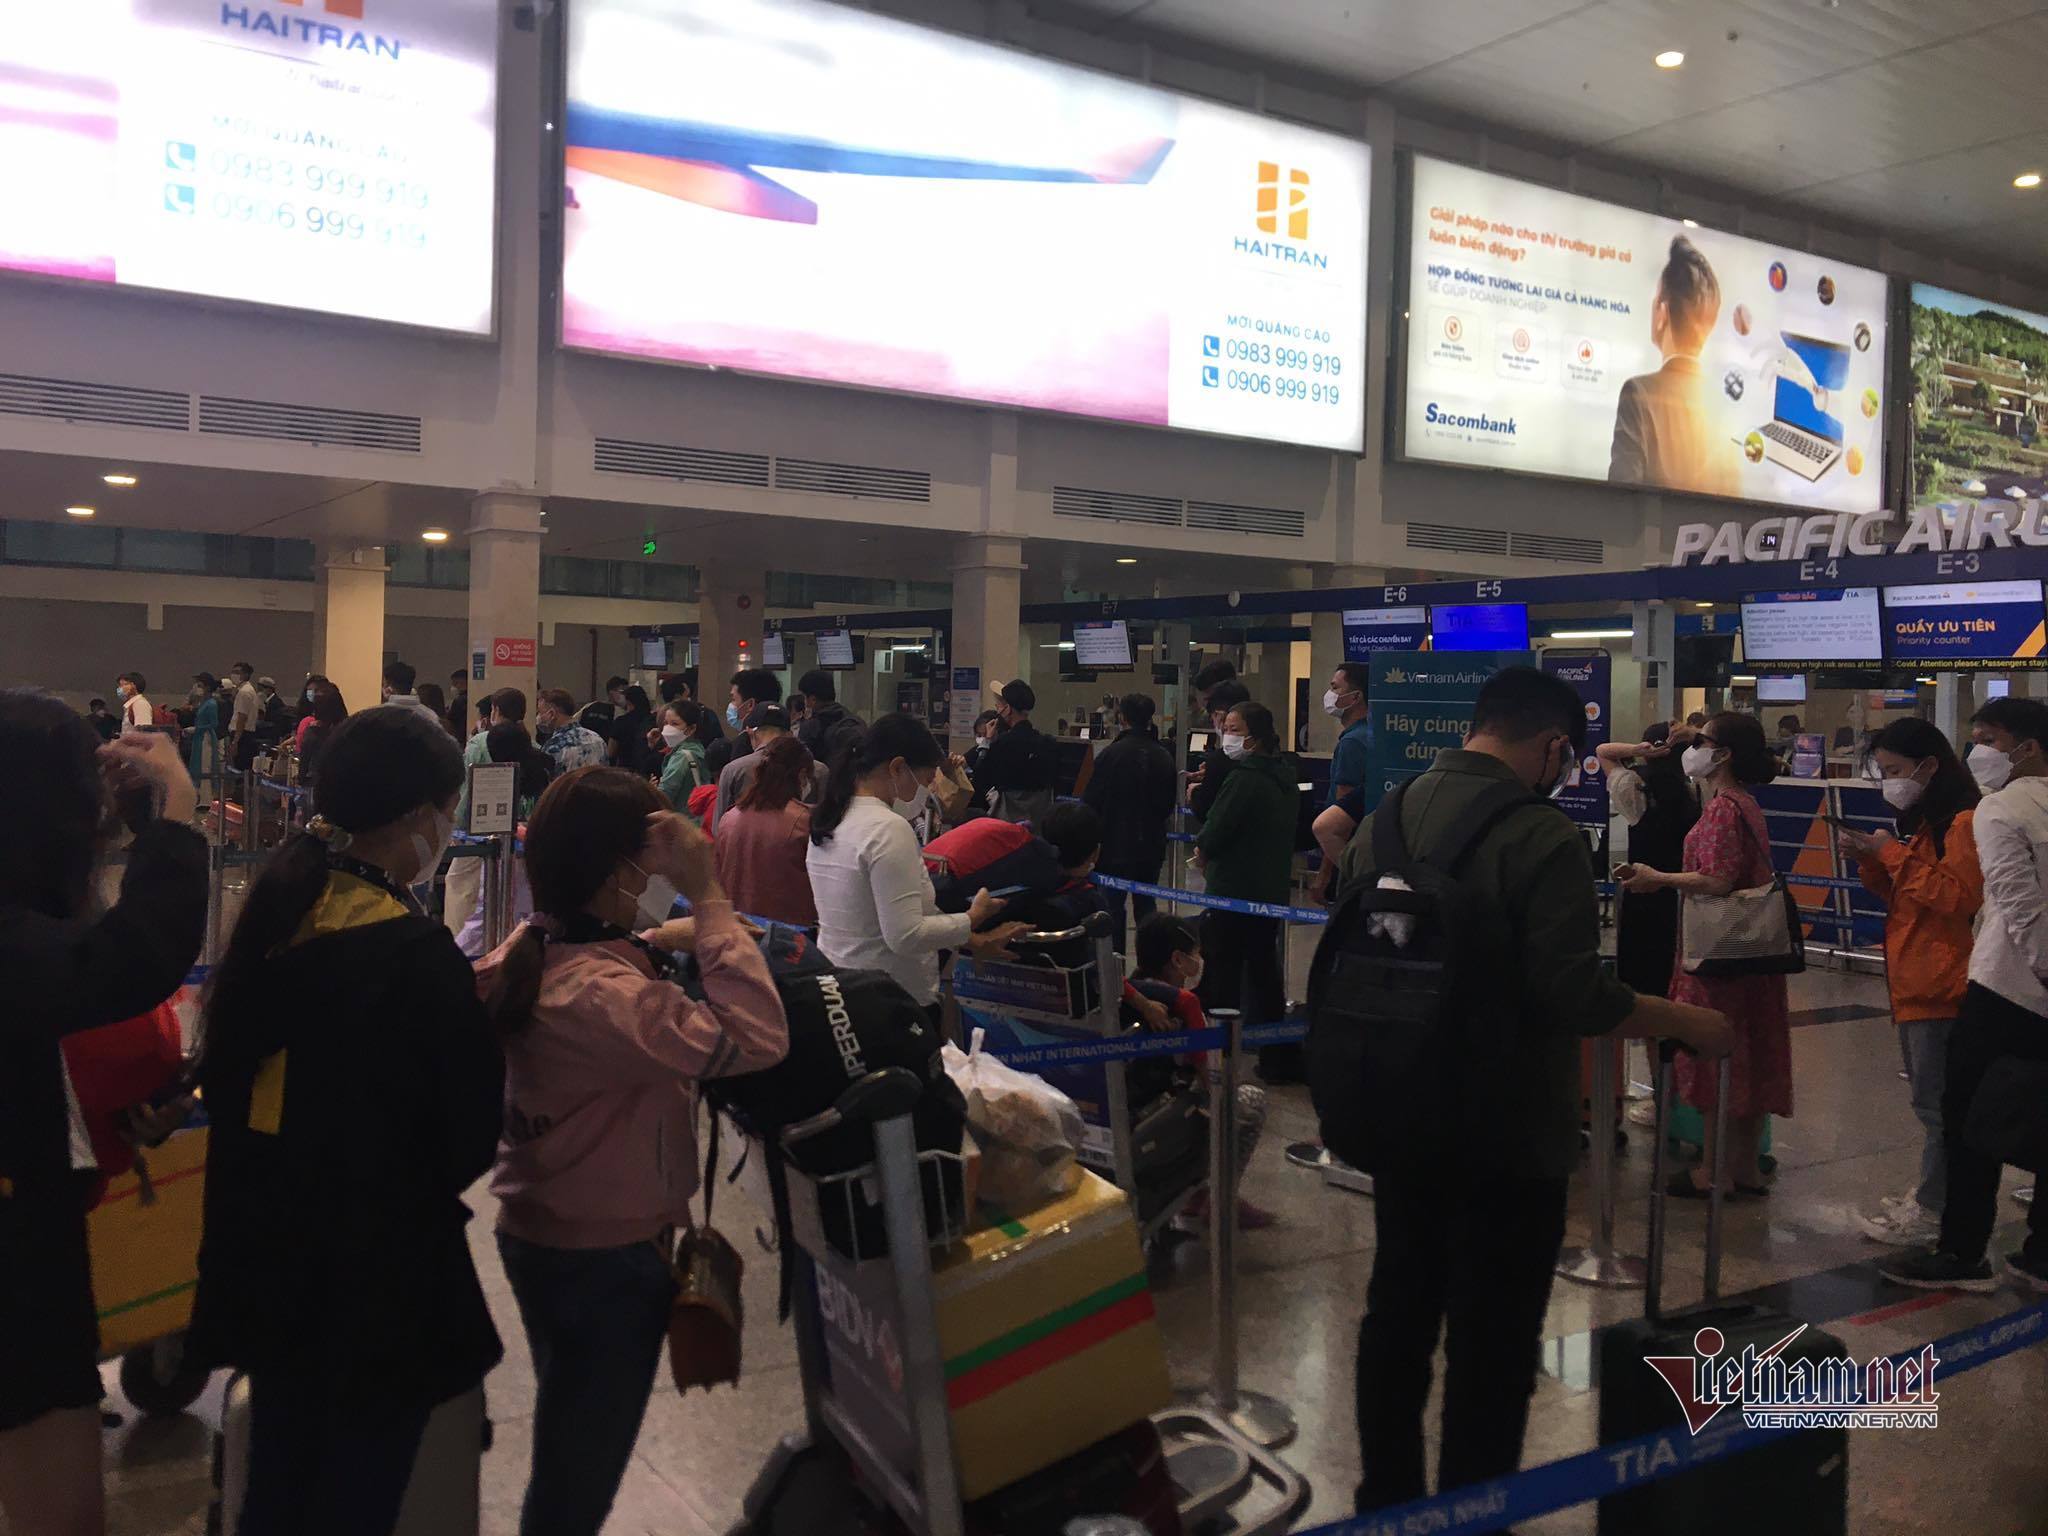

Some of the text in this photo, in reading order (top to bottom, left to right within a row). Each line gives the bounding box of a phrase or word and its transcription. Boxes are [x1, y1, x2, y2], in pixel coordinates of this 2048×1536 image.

[220, 3, 401, 60] HAITRAN
[305, 165, 366, 200] 999
[305, 206, 366, 241] 999
[1456, 213, 1488, 233] pháp
[1516, 226, 1538, 241] cho
[1234, 236, 1328, 270] HAITRAN
[1428, 264, 1452, 278] HỢP
[1454, 267, 1485, 286] ĐỒNG
[1488, 276, 1524, 293] TƯƠNG
[1526, 285, 1543, 298] LAI
[1545, 286, 1562, 301] GIÁ
[1580, 292, 1608, 310] HÀNG
[1469, 287, 1508, 306] DOANH
[1226, 338, 1341, 376] 0983 999 919
[1227, 369, 1340, 405] 0906 999 919
[1425, 402, 1517, 435] Sacombank
[1672, 509, 1894, 566] PACIFIC
[1800, 552, 1981, 581] E-4 E-3
[1384, 586, 1407, 603] E-6
[1477, 581, 1502, 598] E-5
[1897, 635, 1971, 646] Priority counter
[1407, 671, 1454, 684] Vietnam
[1557, 667, 1584, 675] PACIFIC
[1919, 659, 1953, 668] Attention
[1982, 659, 2027, 669] Passengers
[1385, 713, 1420, 737] Hãy
[1097, 874, 1116, 888] TIA
[1247, 902, 1269, 915] TIA
[1045, 1042, 1138, 1061] INTERNATIONAL
[1139, 1035, 1190, 1052] AIRPORT
[1608, 1437, 1679, 1484] TIA
